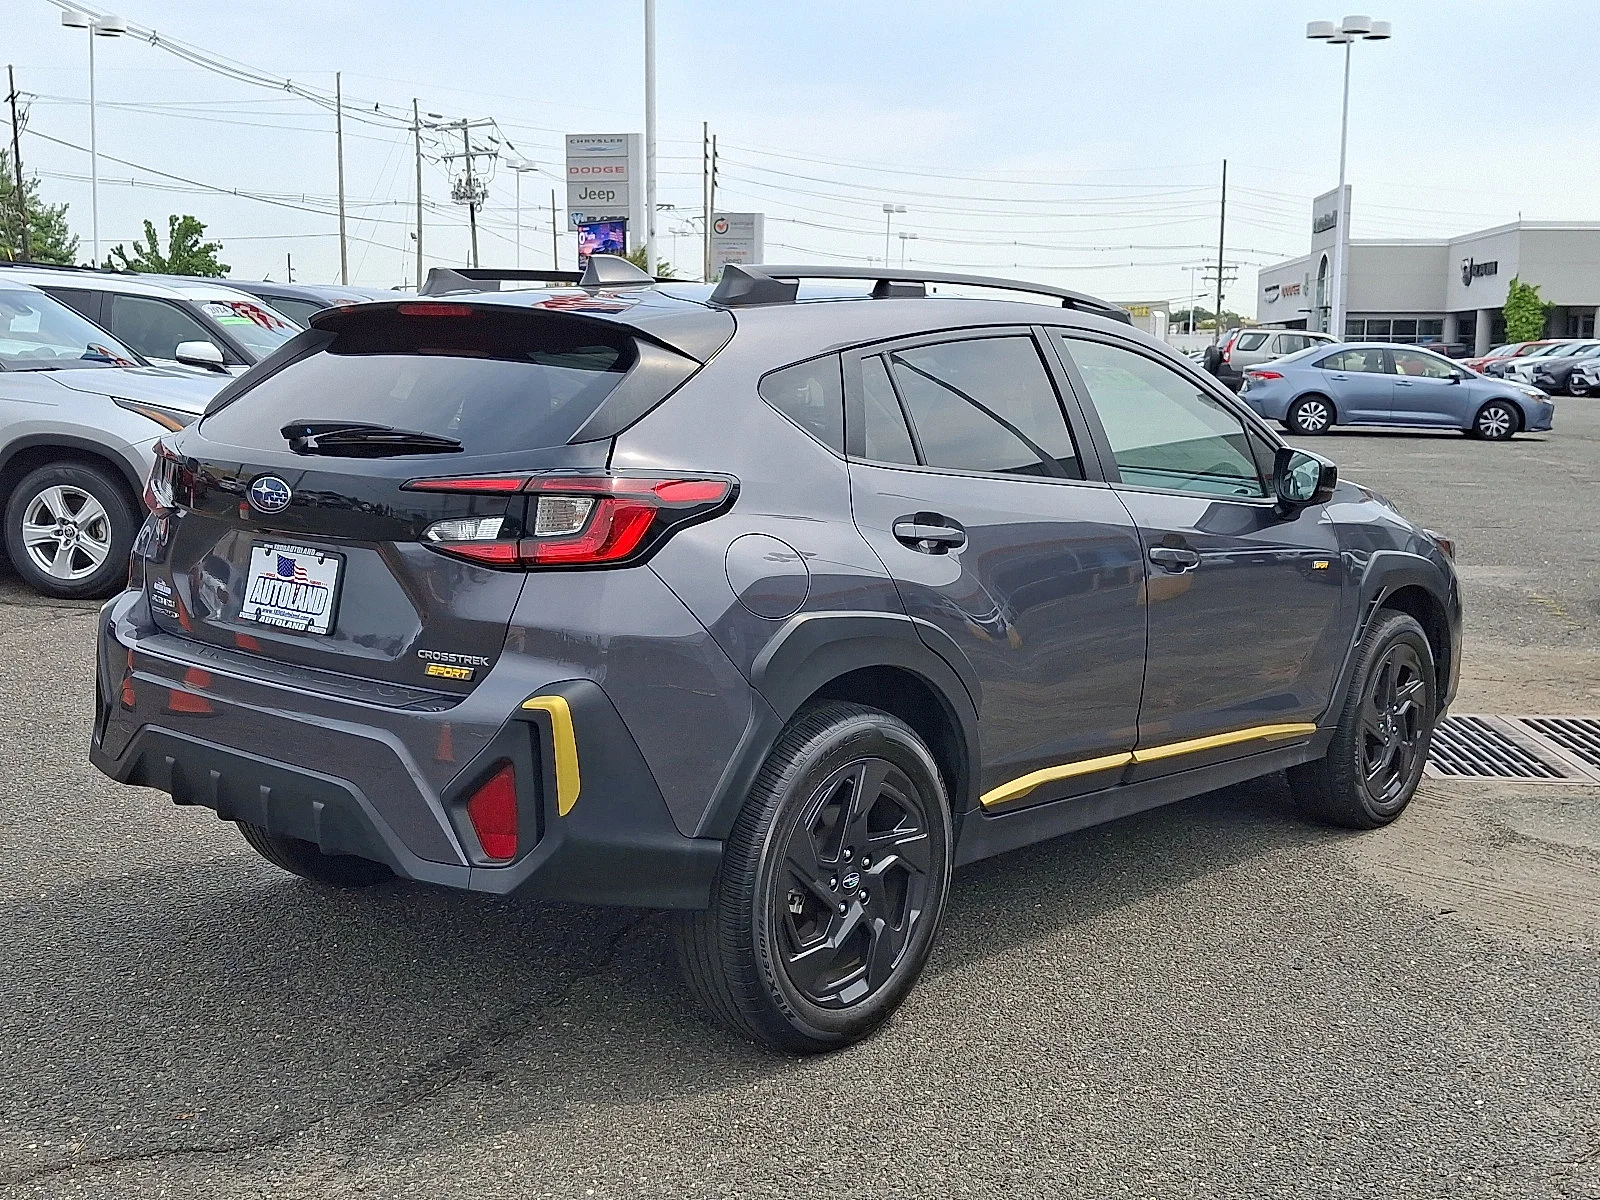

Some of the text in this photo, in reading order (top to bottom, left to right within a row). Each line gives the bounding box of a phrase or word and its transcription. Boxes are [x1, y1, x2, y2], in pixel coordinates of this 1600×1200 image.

[570, 166, 625, 174] DODGE
[579, 187, 616, 202] Jeep
[249, 576, 329, 616] AUTOLAND
[259, 615, 306, 631] AUTOLAND
[417, 649, 490, 667] CROSSTREK
[427, 665, 470, 680] SPORT
